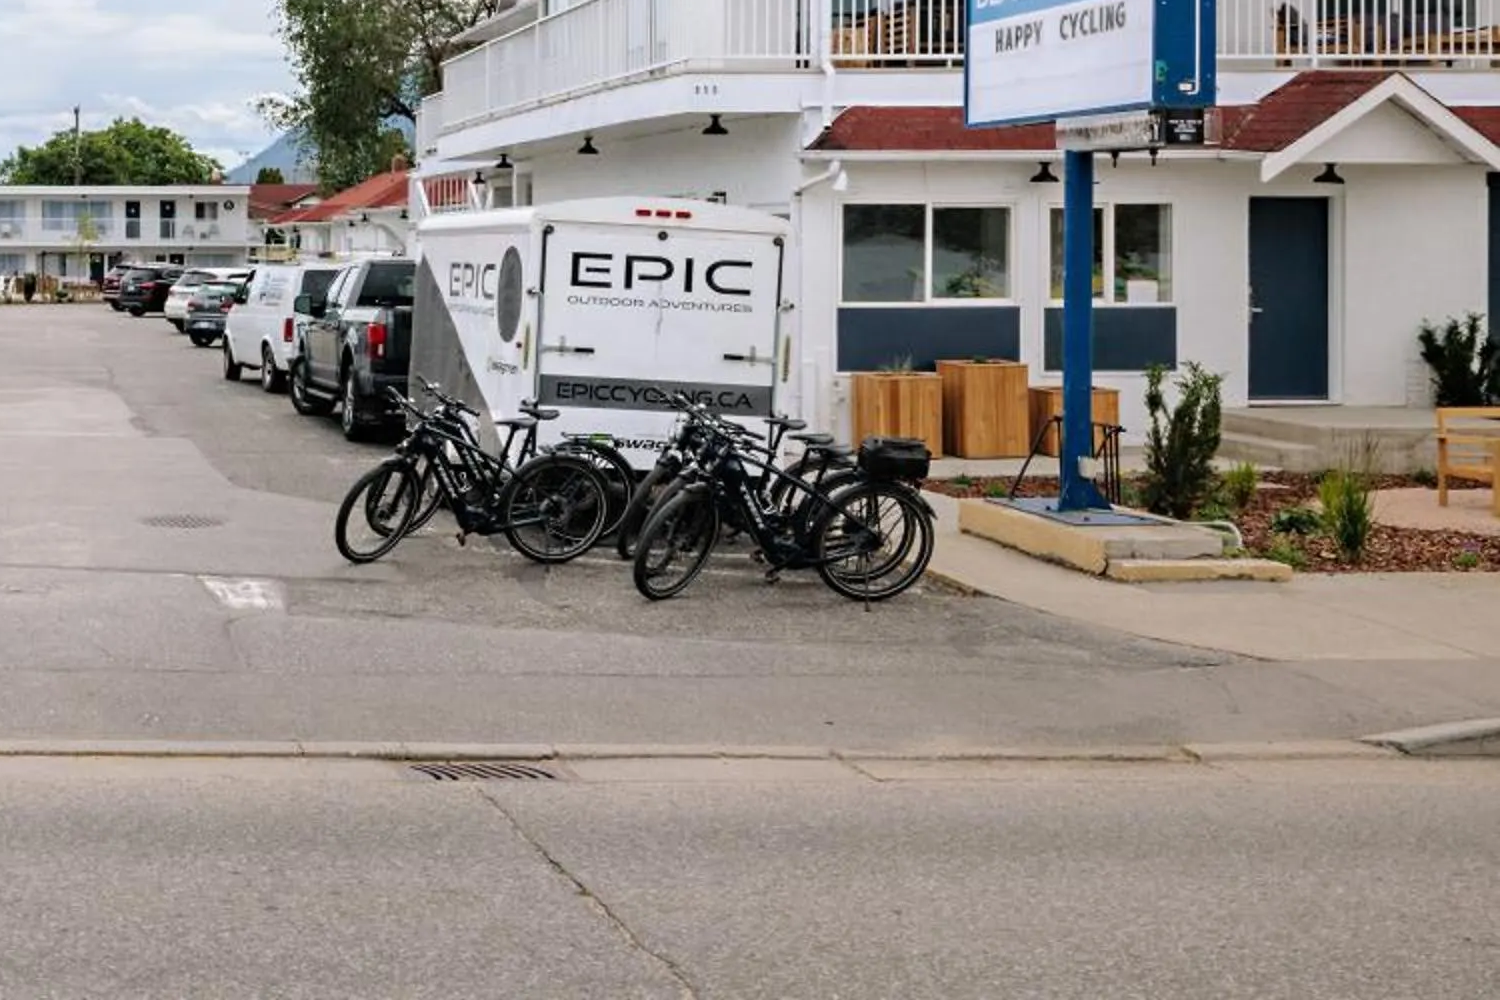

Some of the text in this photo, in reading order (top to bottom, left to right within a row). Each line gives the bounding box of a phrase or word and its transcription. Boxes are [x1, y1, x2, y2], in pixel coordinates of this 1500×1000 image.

[995, 2, 1126, 53] HAPPY CYCLING
[449, 262, 496, 299] EPIC
[570, 252, 753, 296] EPIC
[567, 295, 753, 313] OUTDOOR ADVENTURES
